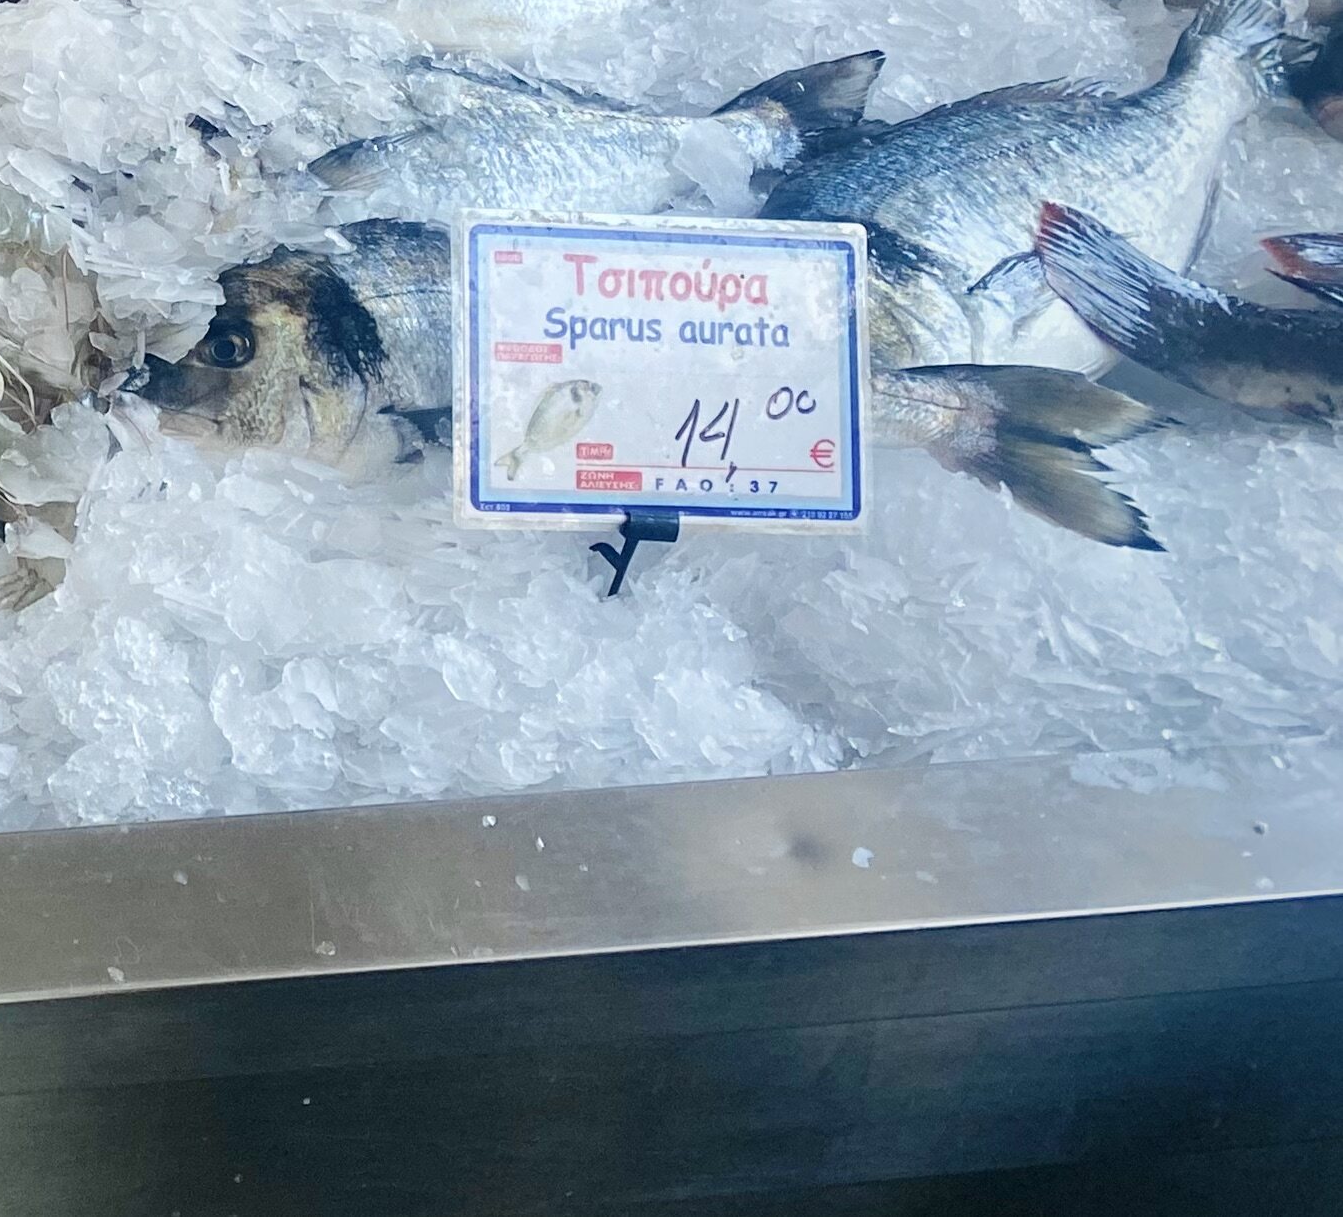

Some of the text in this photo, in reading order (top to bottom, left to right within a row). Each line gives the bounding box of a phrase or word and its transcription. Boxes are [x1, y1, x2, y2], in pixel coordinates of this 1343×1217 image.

[562, 253, 769, 312] Τσιπούρα
[543, 306, 791, 350] Sparus aurata
[655, 477, 714, 493] FAO
[749, 480, 779, 494] 37
